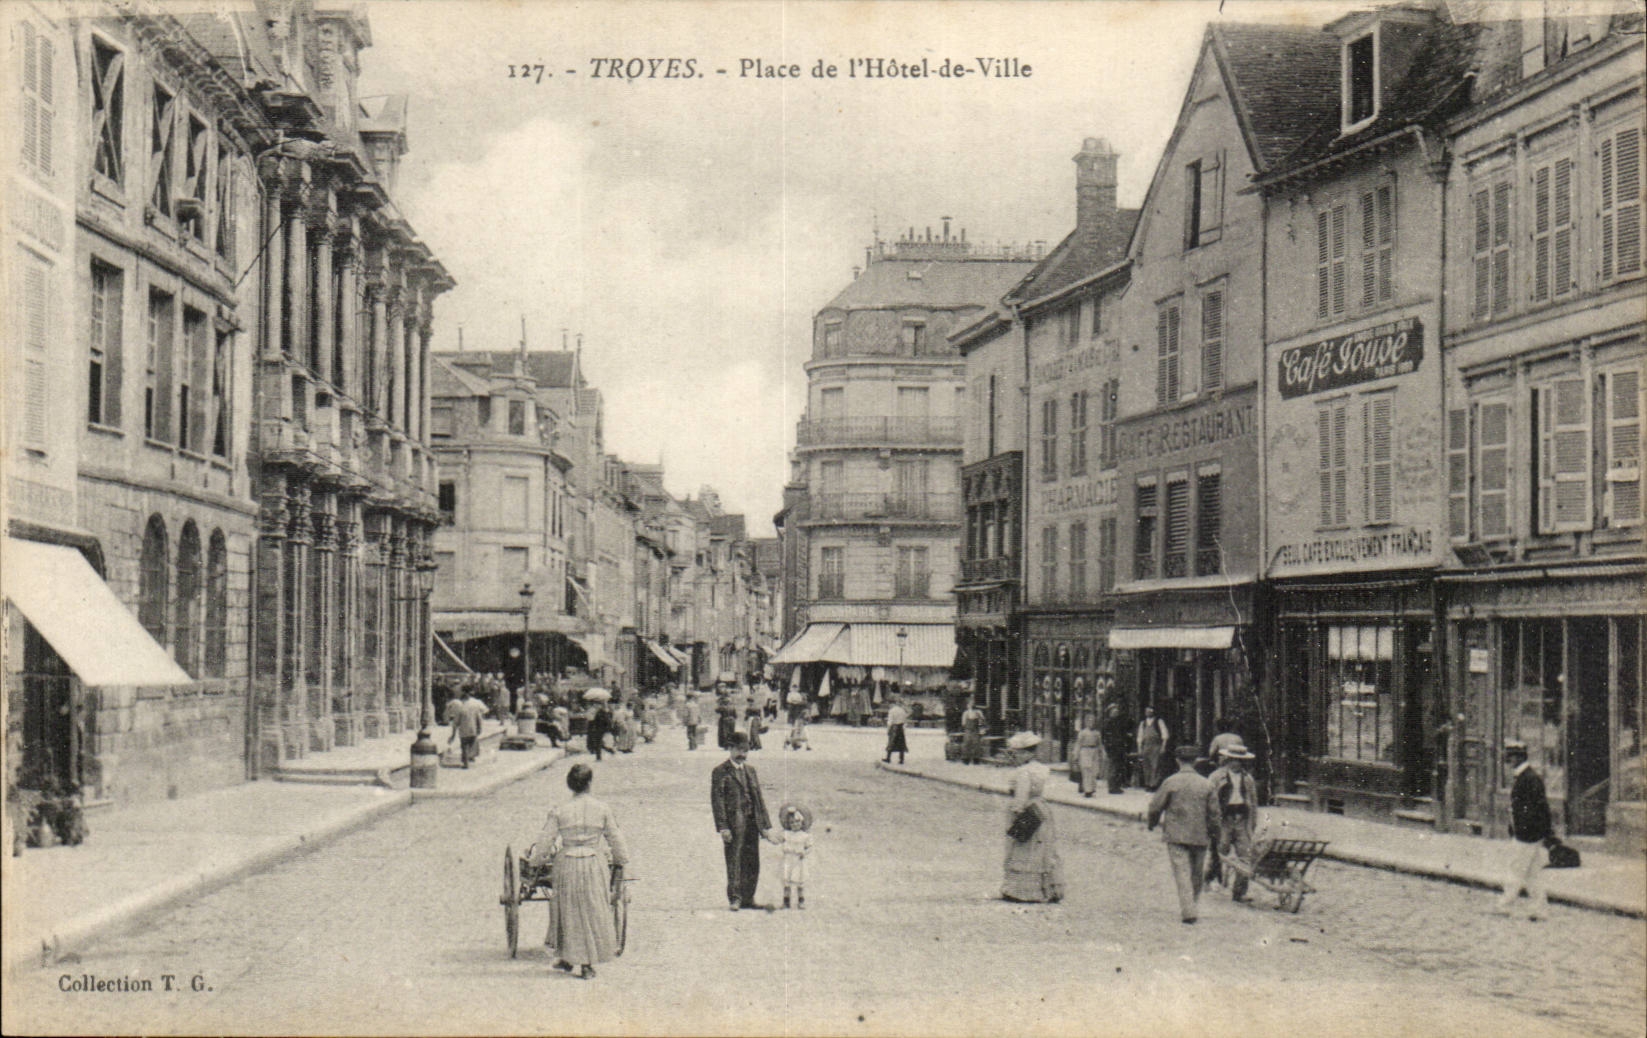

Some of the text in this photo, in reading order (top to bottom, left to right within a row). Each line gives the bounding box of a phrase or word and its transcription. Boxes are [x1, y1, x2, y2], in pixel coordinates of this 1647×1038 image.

[1282, 341, 1334, 391] Café
[1159, 405, 1253, 454] RESTAURANT
[1041, 478, 1118, 514] PHARMACIE
[1283, 545, 1301, 565] SEUL
[1324, 534, 1389, 562] EXCLUSIVEMENT
[1391, 528, 1432, 556] FRANÇAIS
